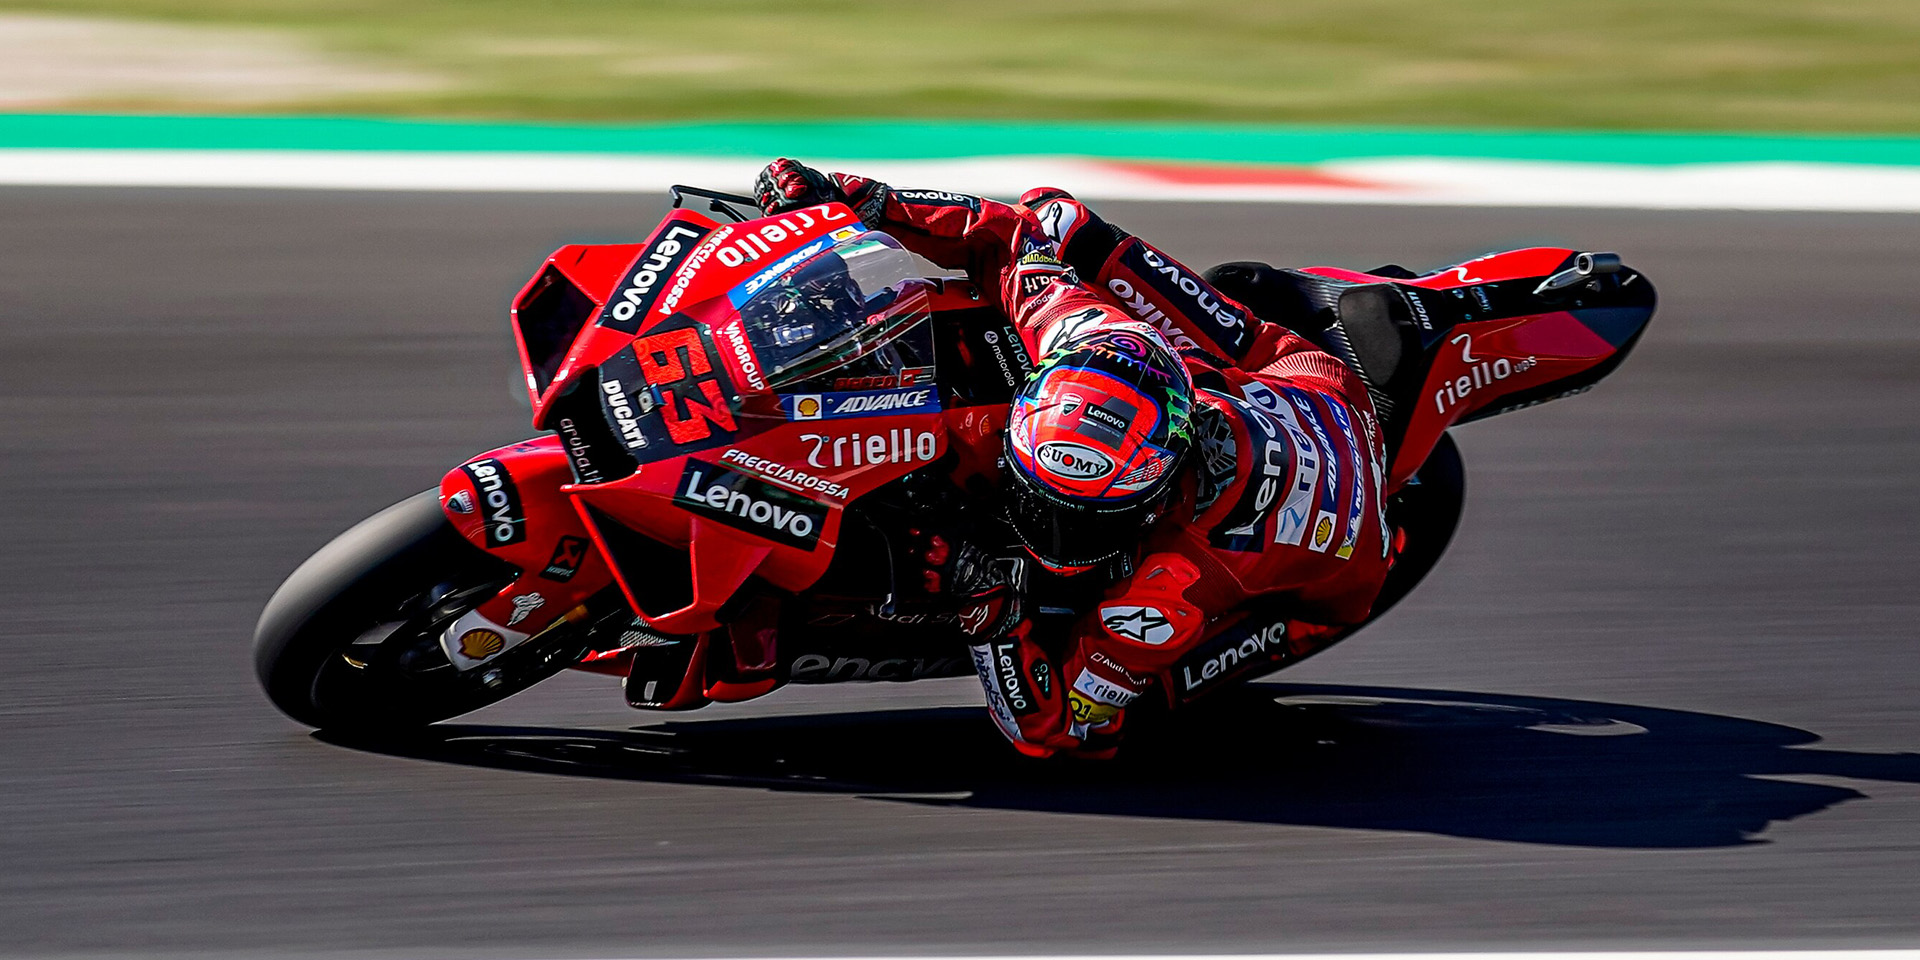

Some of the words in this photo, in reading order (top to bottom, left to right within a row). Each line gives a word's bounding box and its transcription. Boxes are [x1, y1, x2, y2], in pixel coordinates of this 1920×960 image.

[901, 190, 974, 210] Lenovo
[716, 211, 815, 268] riello
[744, 241, 824, 295] ADVANCE
[612, 226, 700, 322] Lenovo
[658, 225, 735, 316] FRECCIAROSSA
[1143, 250, 1245, 347] Lenovo
[1407, 291, 1433, 330] DUCATI
[724, 321, 765, 391] VARGROUP
[992, 344, 1015, 387] motorola
[1435, 358, 1512, 414] riello
[1514, 355, 1538, 372] ups
[601, 379, 649, 449] DUCATI
[632, 327, 738, 445] 63
[833, 389, 931, 414] ADVANCE
[1087, 405, 1126, 430] Lenovo
[721, 449, 850, 500] FRECCIAROSSA
[832, 428, 937, 468] riello
[1042, 444, 1107, 477] SUOMY
[467, 459, 515, 542] Lenovo
[685, 470, 813, 537] Lenovo
[997, 643, 1027, 710] Lenovo
[1102, 658, 1125, 674] Audi
[1183, 622, 1286, 691] Lenovo
